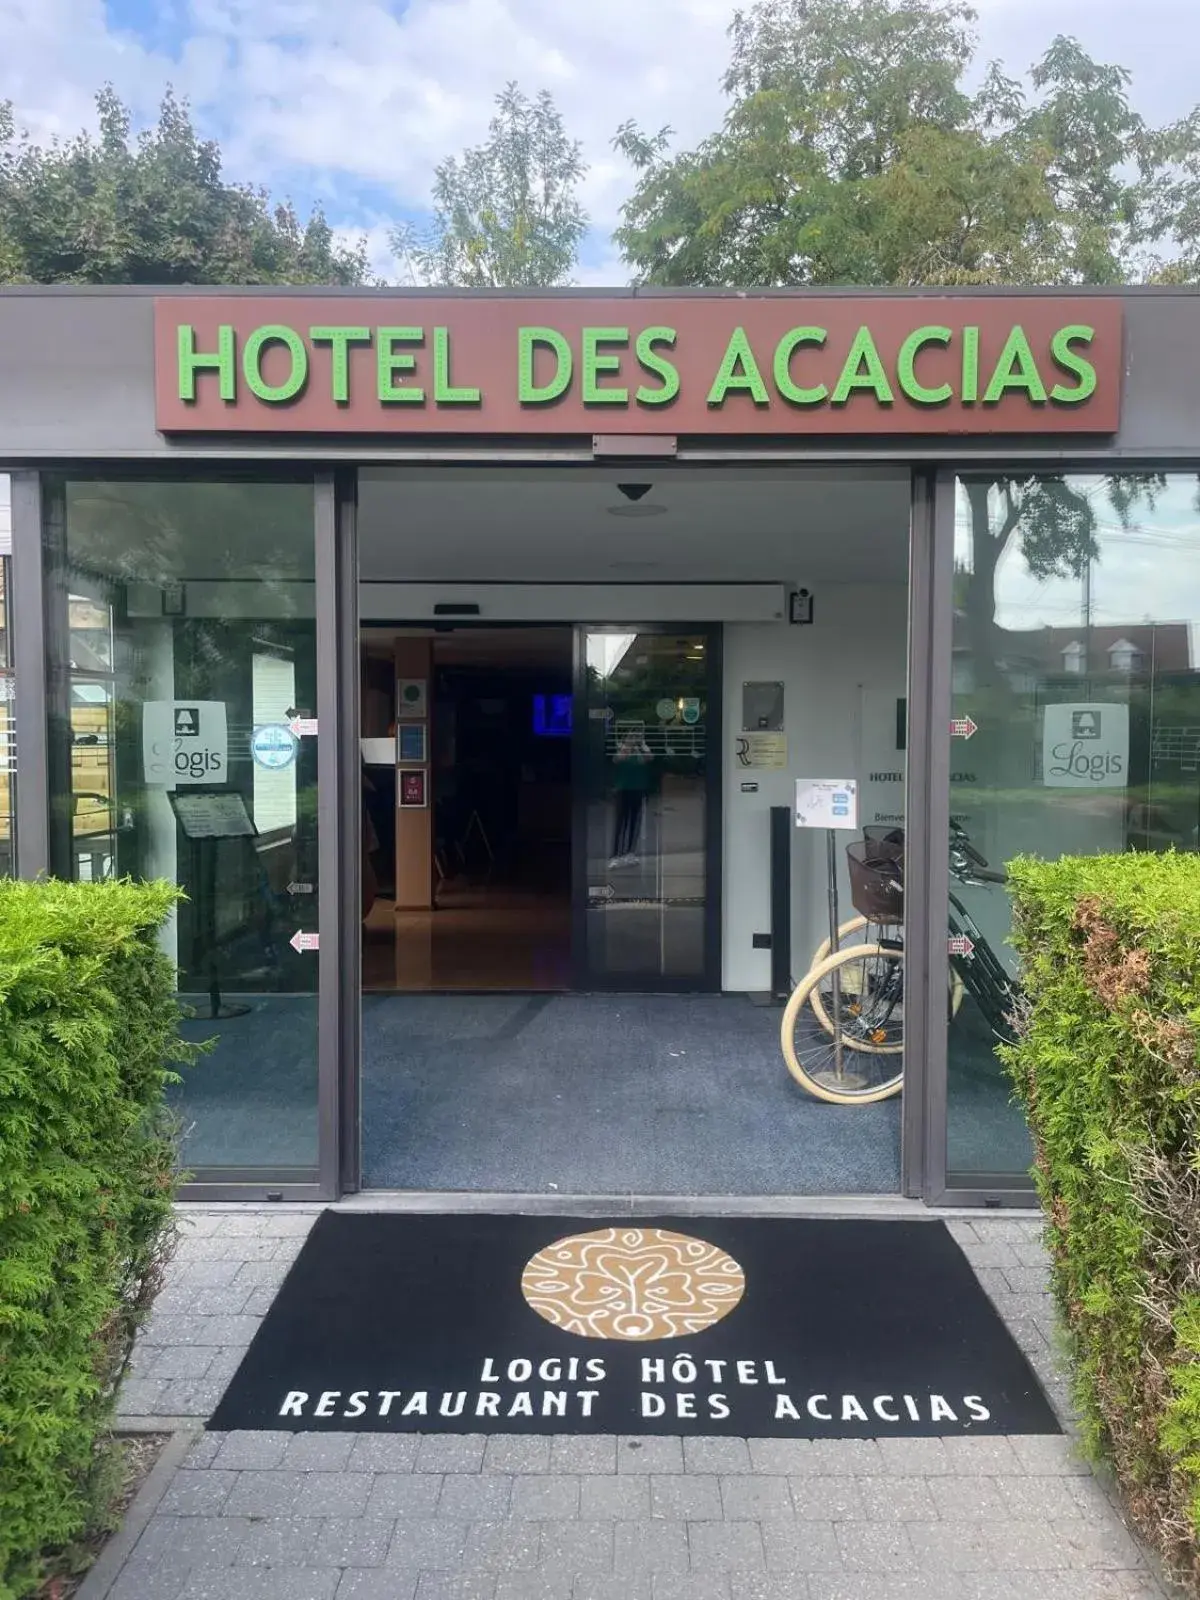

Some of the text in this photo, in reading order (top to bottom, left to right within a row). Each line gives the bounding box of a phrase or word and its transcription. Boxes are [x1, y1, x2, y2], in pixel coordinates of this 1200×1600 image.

[177, 324, 1098, 406] HOTEL DES ACACIAS
[869, 772, 904, 783] HOTEL
[1049, 740, 1123, 782] Logis
[874, 811, 906, 823] Bienve
[479, 1352, 788, 1386] LOGIS HÔTEL
[277, 1390, 992, 1422] RESTAURANT DES ACACIAS
